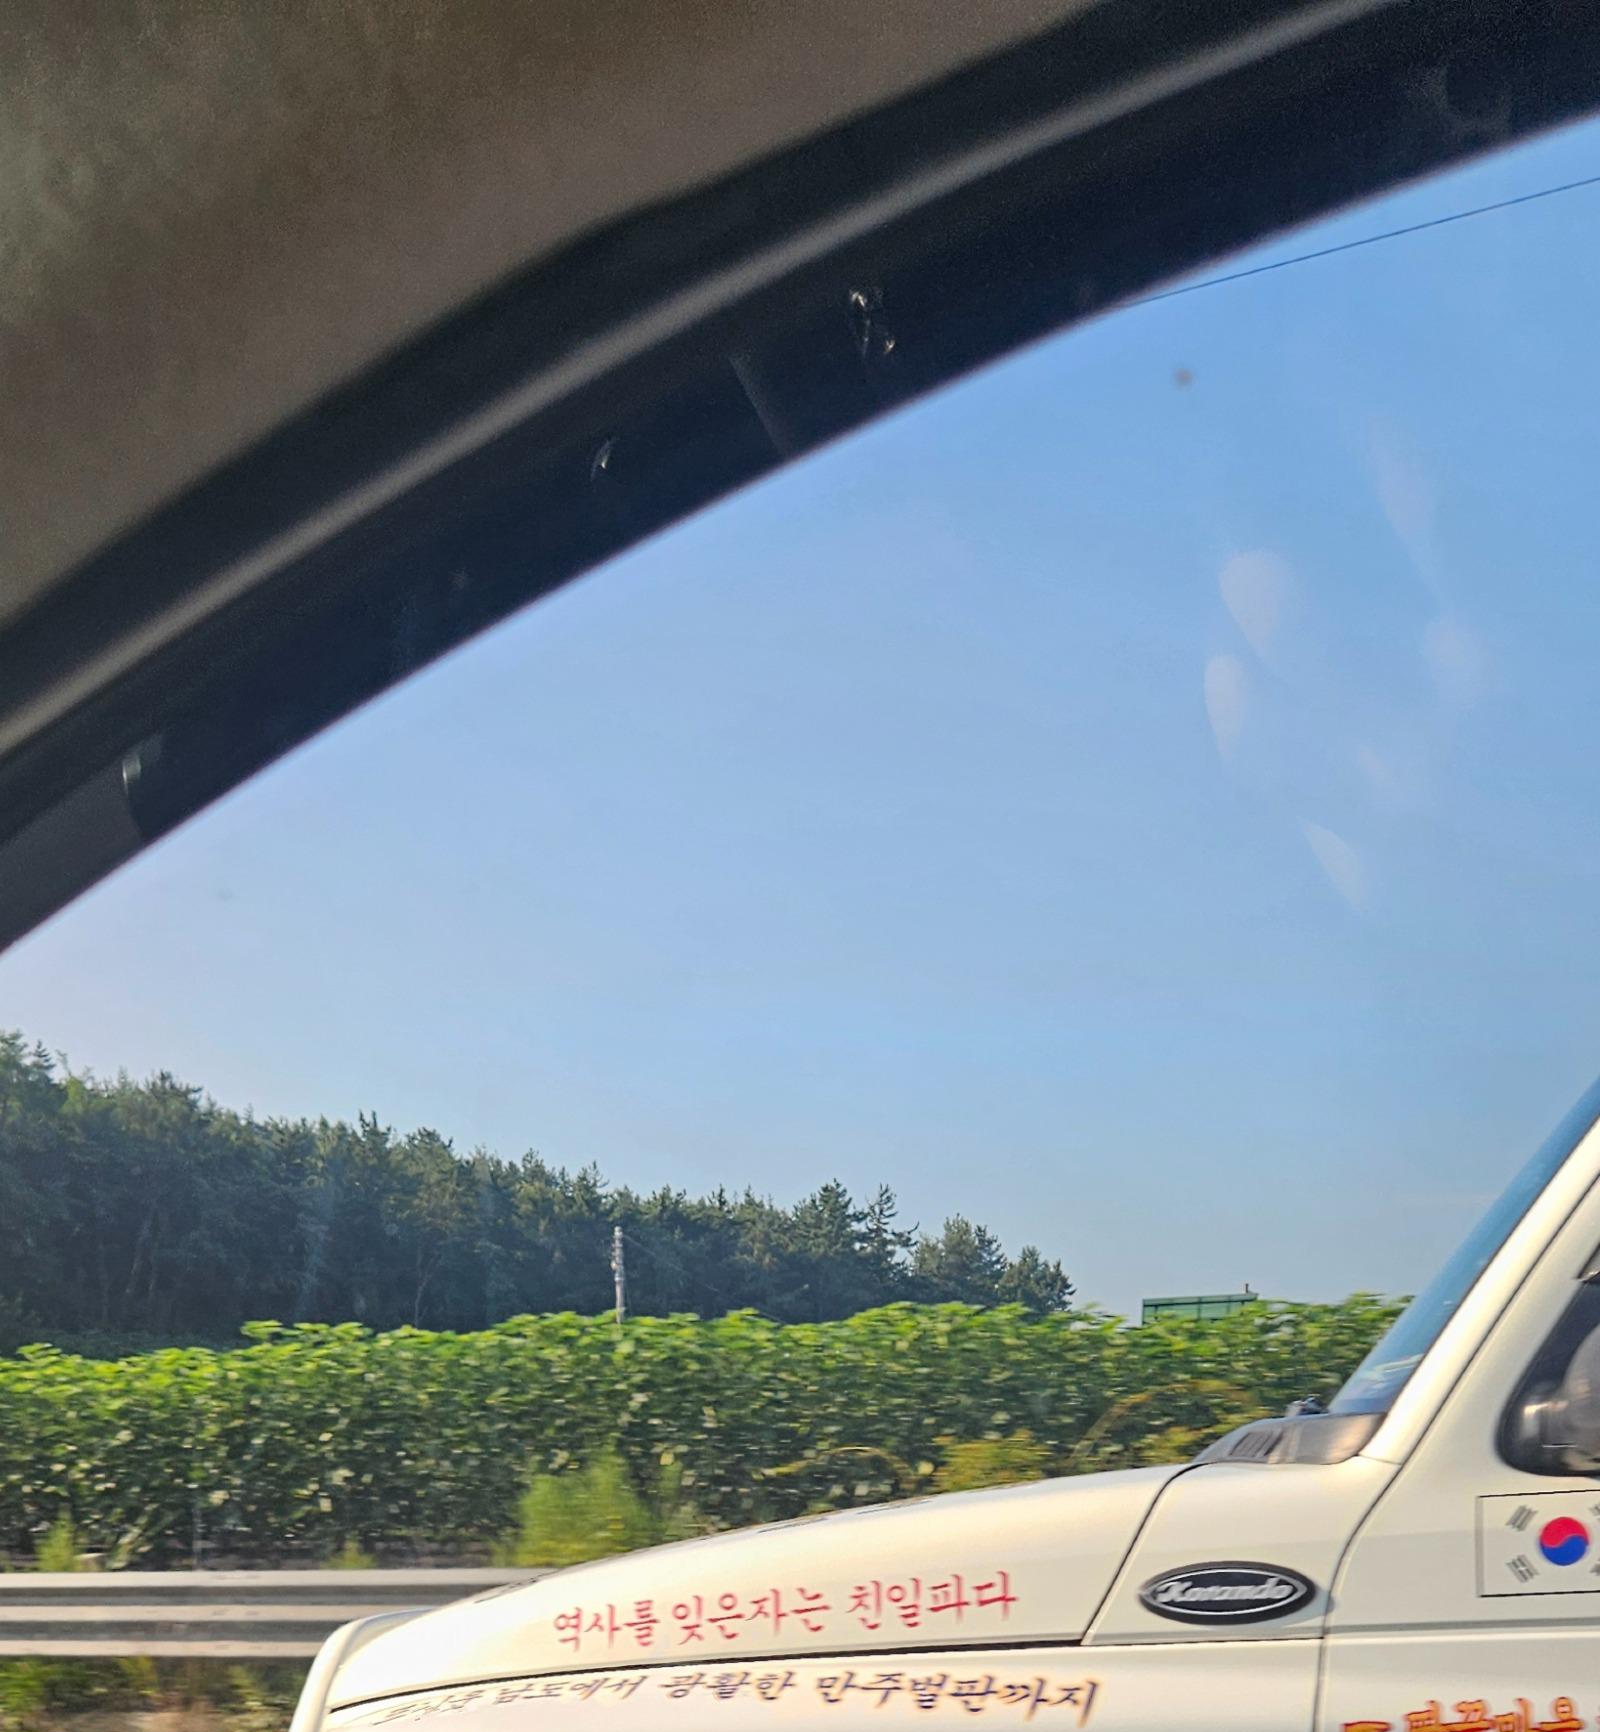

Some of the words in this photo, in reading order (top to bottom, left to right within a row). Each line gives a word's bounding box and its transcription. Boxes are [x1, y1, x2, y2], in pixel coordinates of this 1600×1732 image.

[554, 1600, 660, 1651] 역사를
[671, 1587, 831, 1645] 잊은자는
[846, 1571, 1019, 1629] 친일파다
[660, 1671, 796, 1701] 광활한
[814, 1671, 1099, 1728] 만주벌판까지
